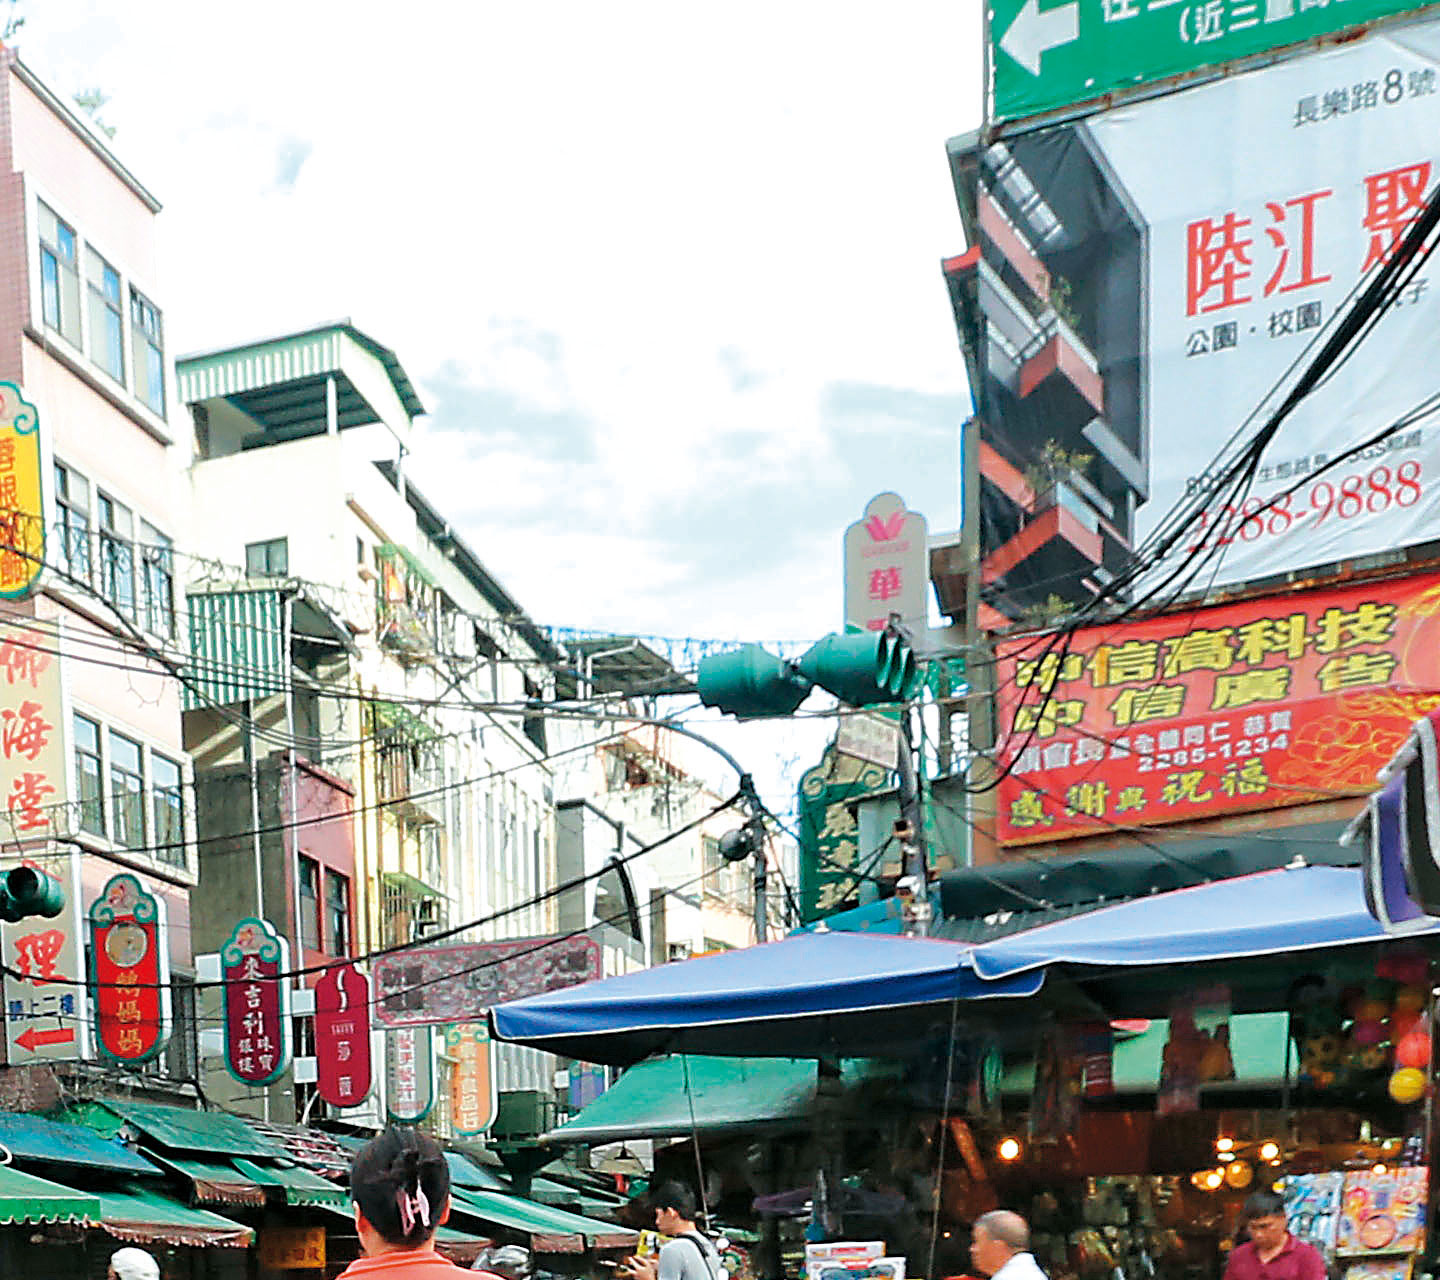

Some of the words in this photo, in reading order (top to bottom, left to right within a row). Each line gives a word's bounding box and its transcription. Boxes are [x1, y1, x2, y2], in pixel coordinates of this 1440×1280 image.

[1292, 69, 1437, 129] 長樂路8號
[1184, 189, 1333, 317] 陸江
[1014, 601, 1399, 694] 中信高科技
[1011, 651, 1401, 741] 中信廣告
[1136, 733, 1290, 774] 2285-1234
